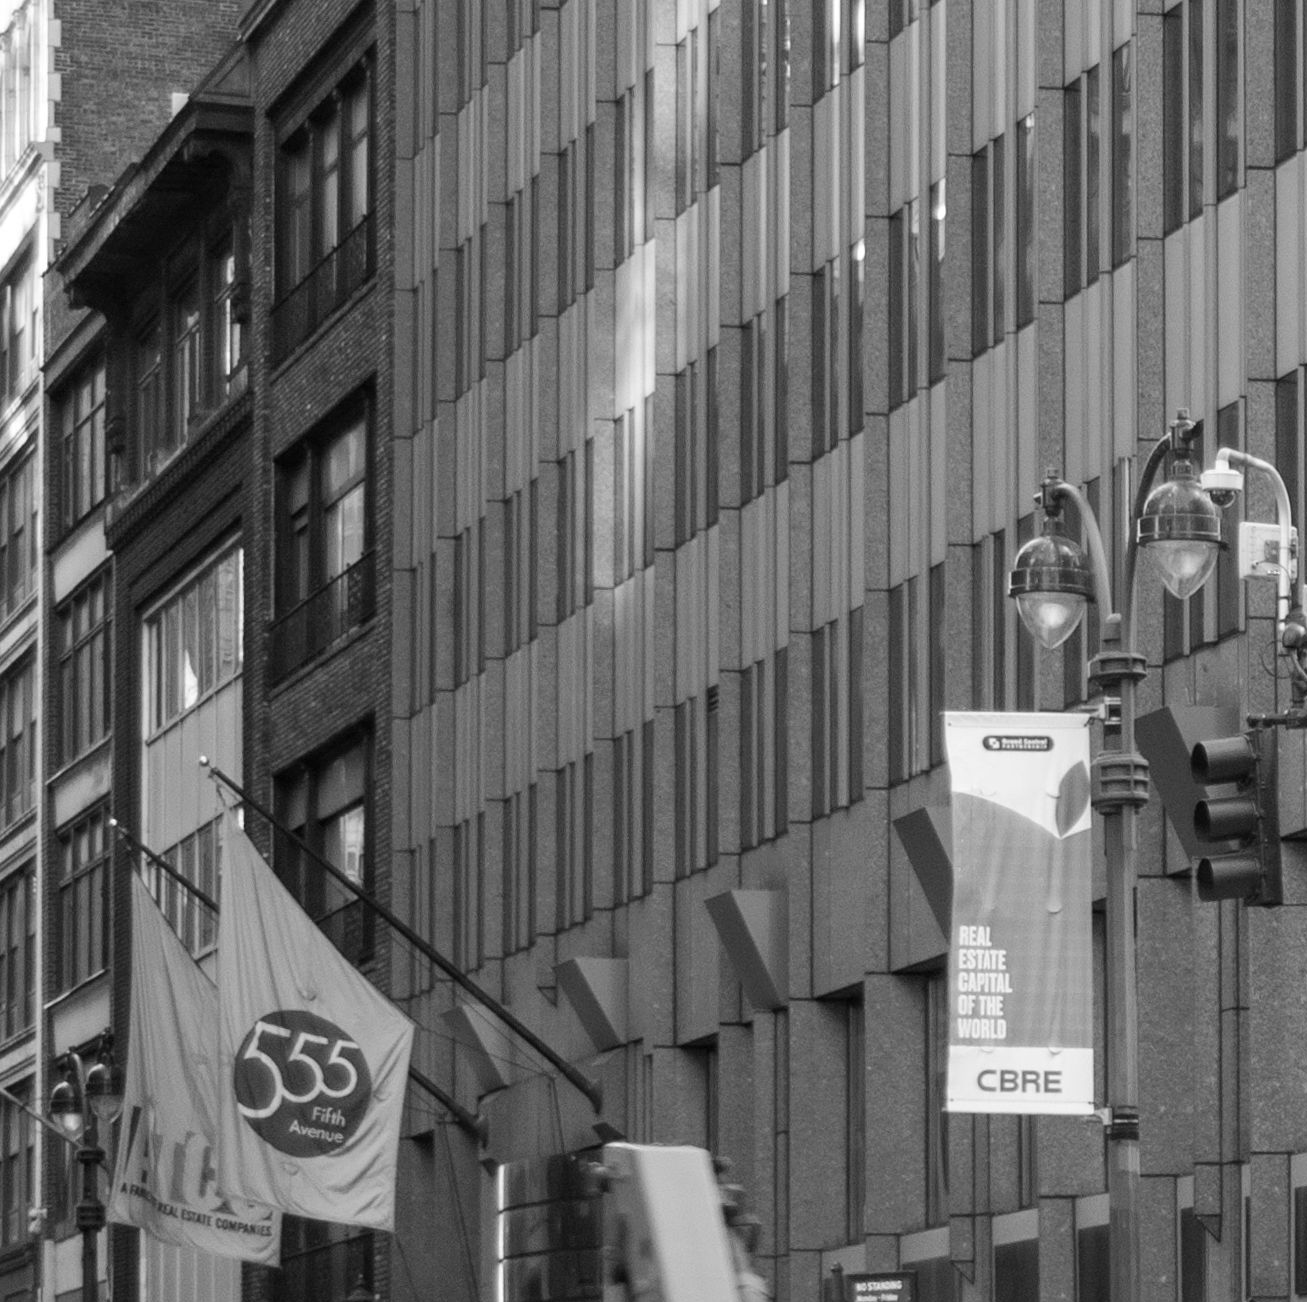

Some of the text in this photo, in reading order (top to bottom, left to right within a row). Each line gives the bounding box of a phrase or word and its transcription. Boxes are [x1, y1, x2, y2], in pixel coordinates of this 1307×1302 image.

[959, 925, 992, 946] REAL
[958, 949, 1007, 970] ESTATE
[958, 972, 1013, 993] CAPITAL
[957, 994, 1004, 1016] OF THE
[957, 1018, 1007, 1039] WORLD
[237, 1021, 360, 1118] 555
[977, 1069, 1062, 1093] CBRE
[311, 1106, 346, 1127] Fifth
[289, 1120, 344, 1143] Avenue
[181, 1209, 212, 1226] ESTATE
[215, 1217, 273, 1237] COMPANIES
